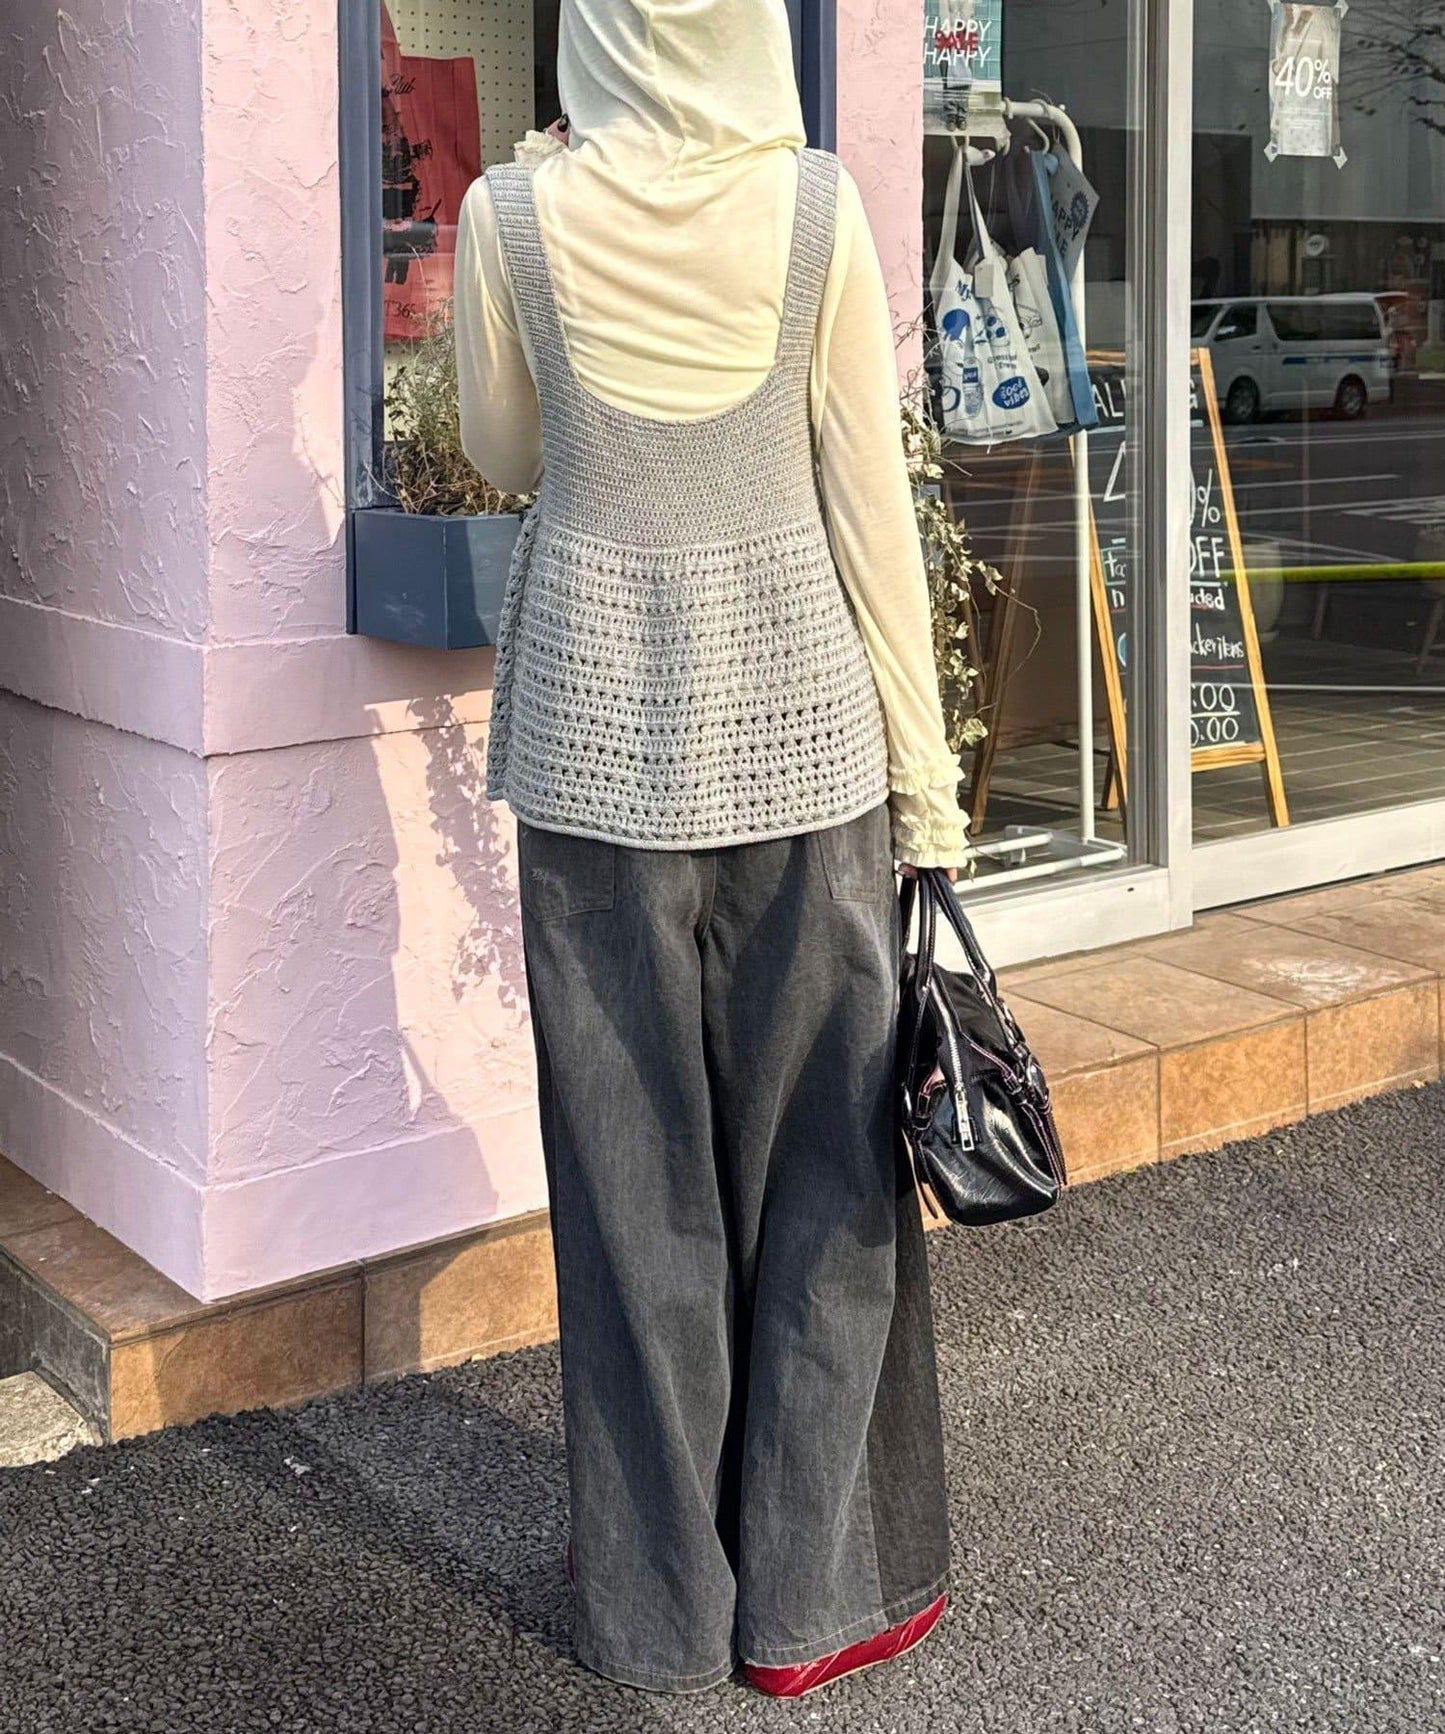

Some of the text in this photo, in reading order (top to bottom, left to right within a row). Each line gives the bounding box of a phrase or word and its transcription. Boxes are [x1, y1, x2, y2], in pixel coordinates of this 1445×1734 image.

[922, 15, 992, 42] HAPPY
[922, 42, 992, 68] HAPPY
[1313, 86, 1333, 99] OFF
